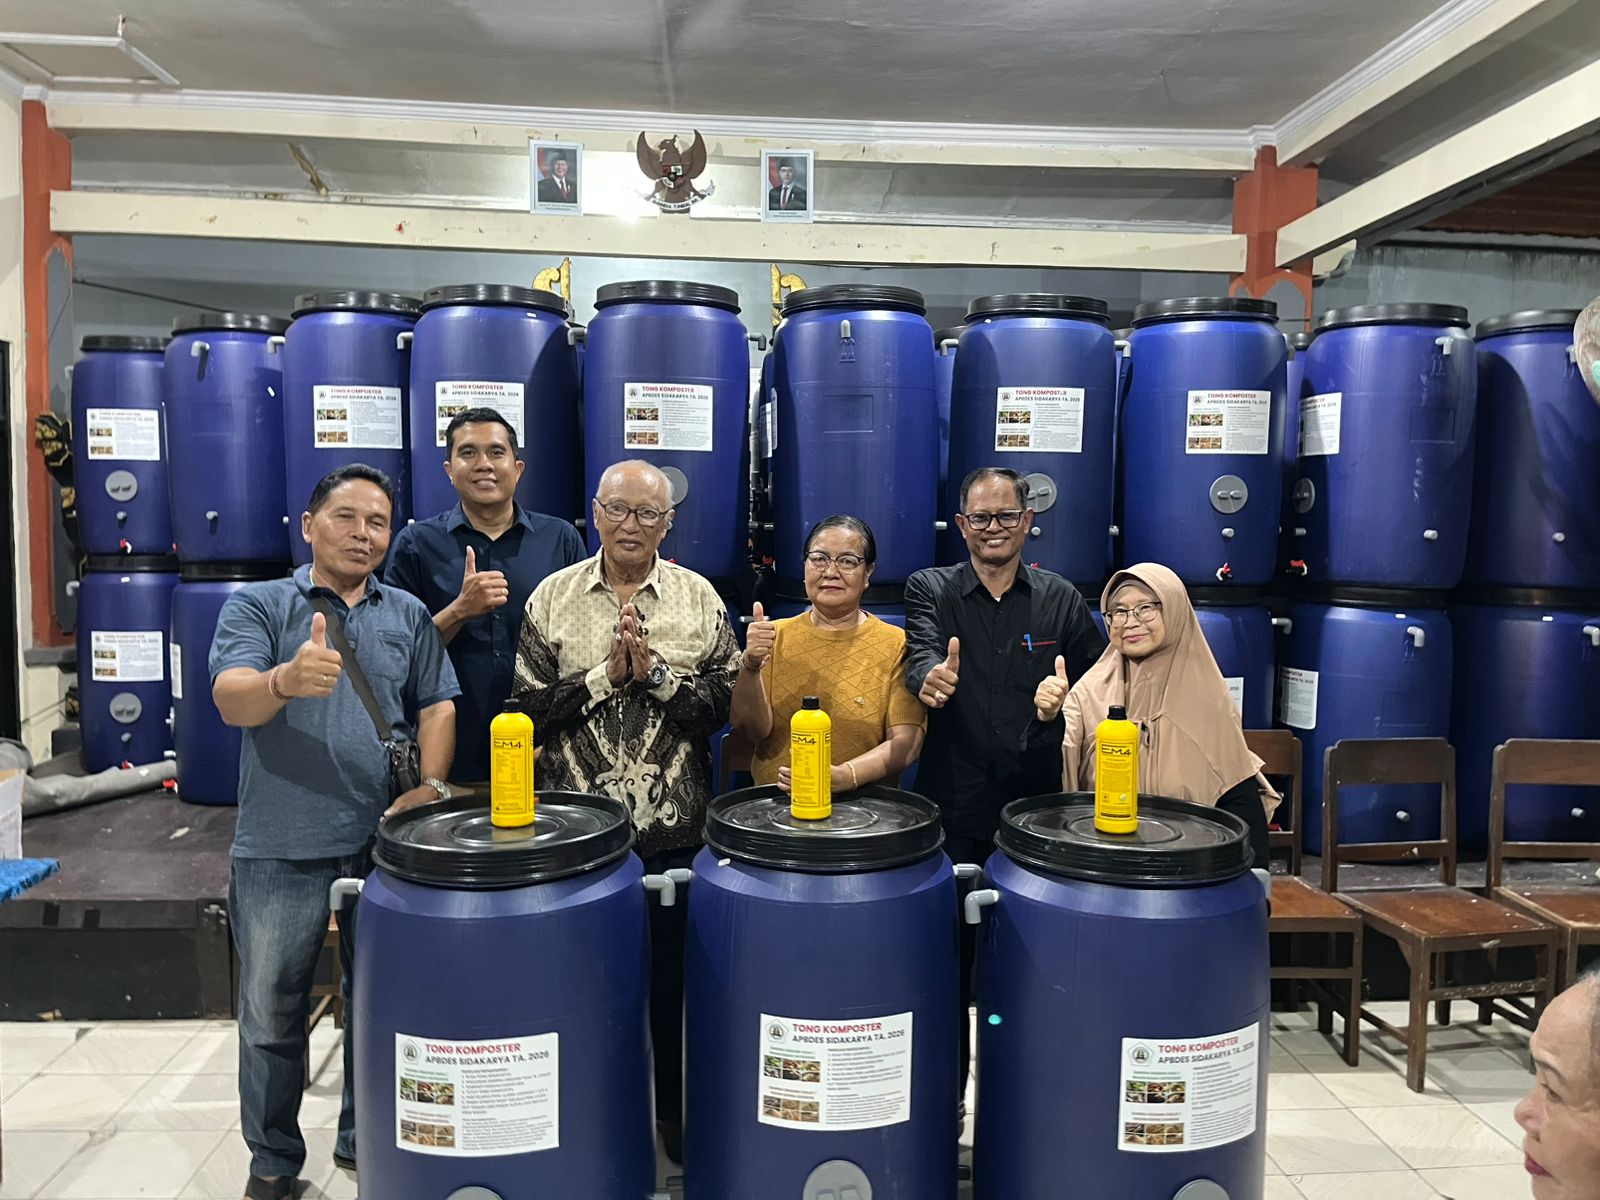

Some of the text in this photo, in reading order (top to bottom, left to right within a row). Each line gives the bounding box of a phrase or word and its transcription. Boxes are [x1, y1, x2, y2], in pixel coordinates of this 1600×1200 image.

[494, 737, 523, 749] EM4
[792, 732, 816, 745] EM4
[1101, 744, 1132, 756] EM4
[793, 1023, 882, 1034] TONG KOMPOSTER
[792, 1035, 824, 1044] APBDES
[826, 1034, 873, 1044] SIDAKARYA
[1158, 1036, 1239, 1053] TONG KOMPOSTER
[425, 1043, 521, 1055] TONG KOMPOSTER
[425, 1056, 458, 1065] APBDES
[459, 1055, 510, 1065] SIDAKARYA
[513, 1055, 527, 1063] TA.
[1158, 1055, 1190, 1064] APBDES
[1192, 1049, 1231, 1063] SIDAKARYA
